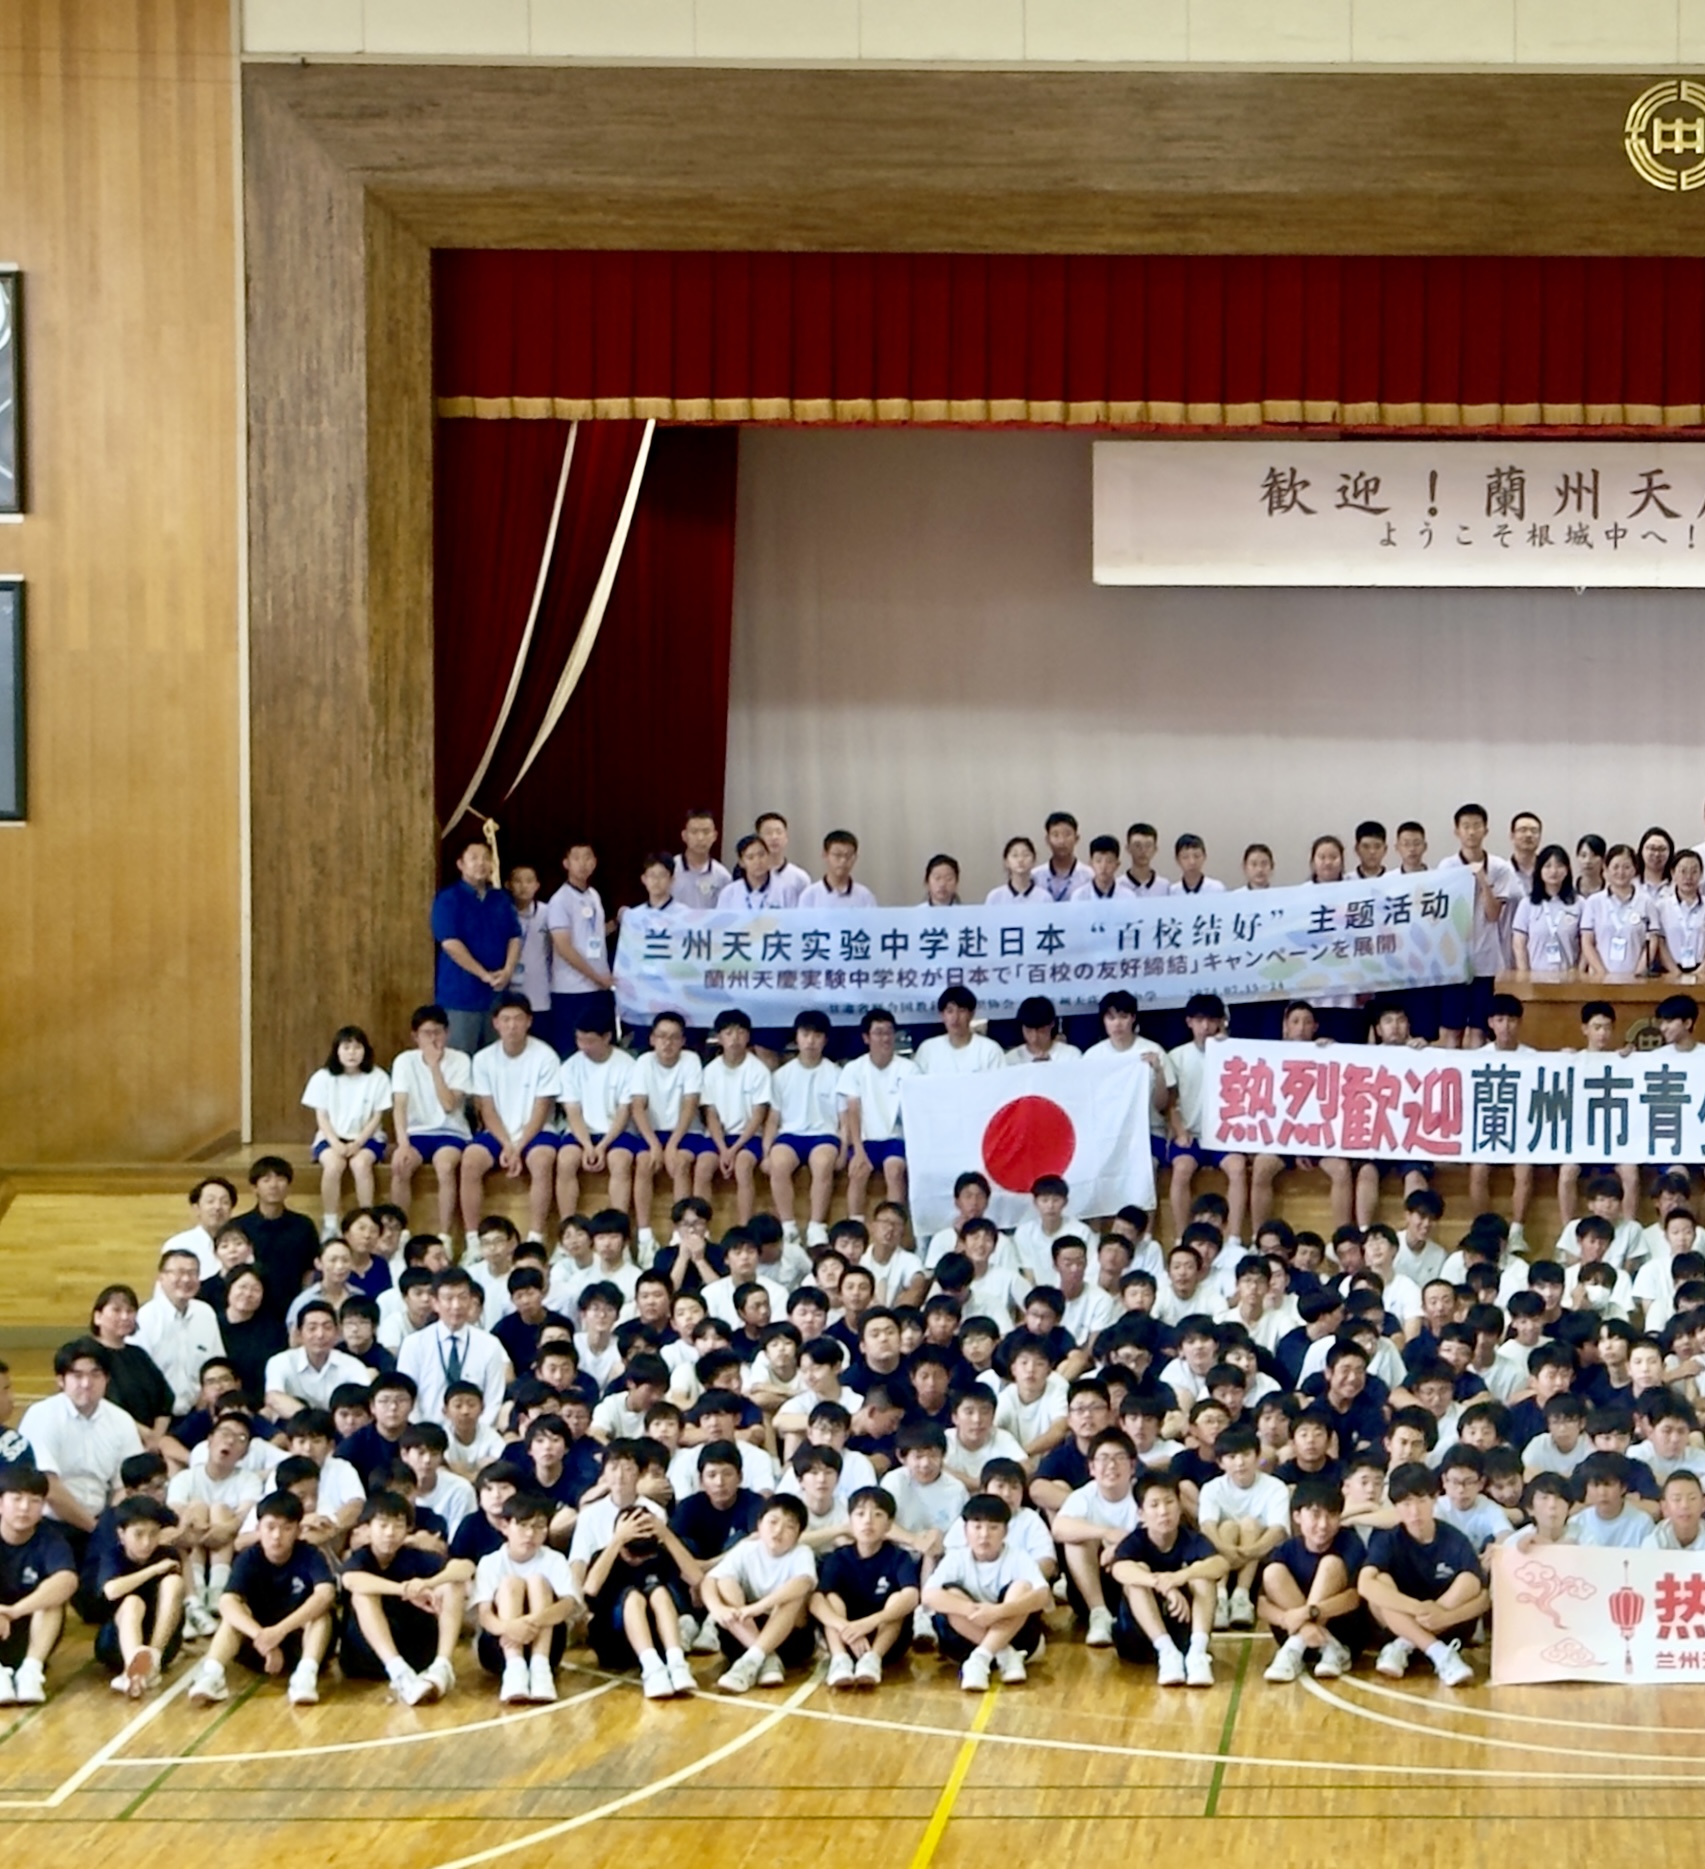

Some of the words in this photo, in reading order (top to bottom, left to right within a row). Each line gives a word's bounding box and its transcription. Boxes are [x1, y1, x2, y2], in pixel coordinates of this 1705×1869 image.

[1379, 522, 1699, 551] ようこそ根城中へ！
